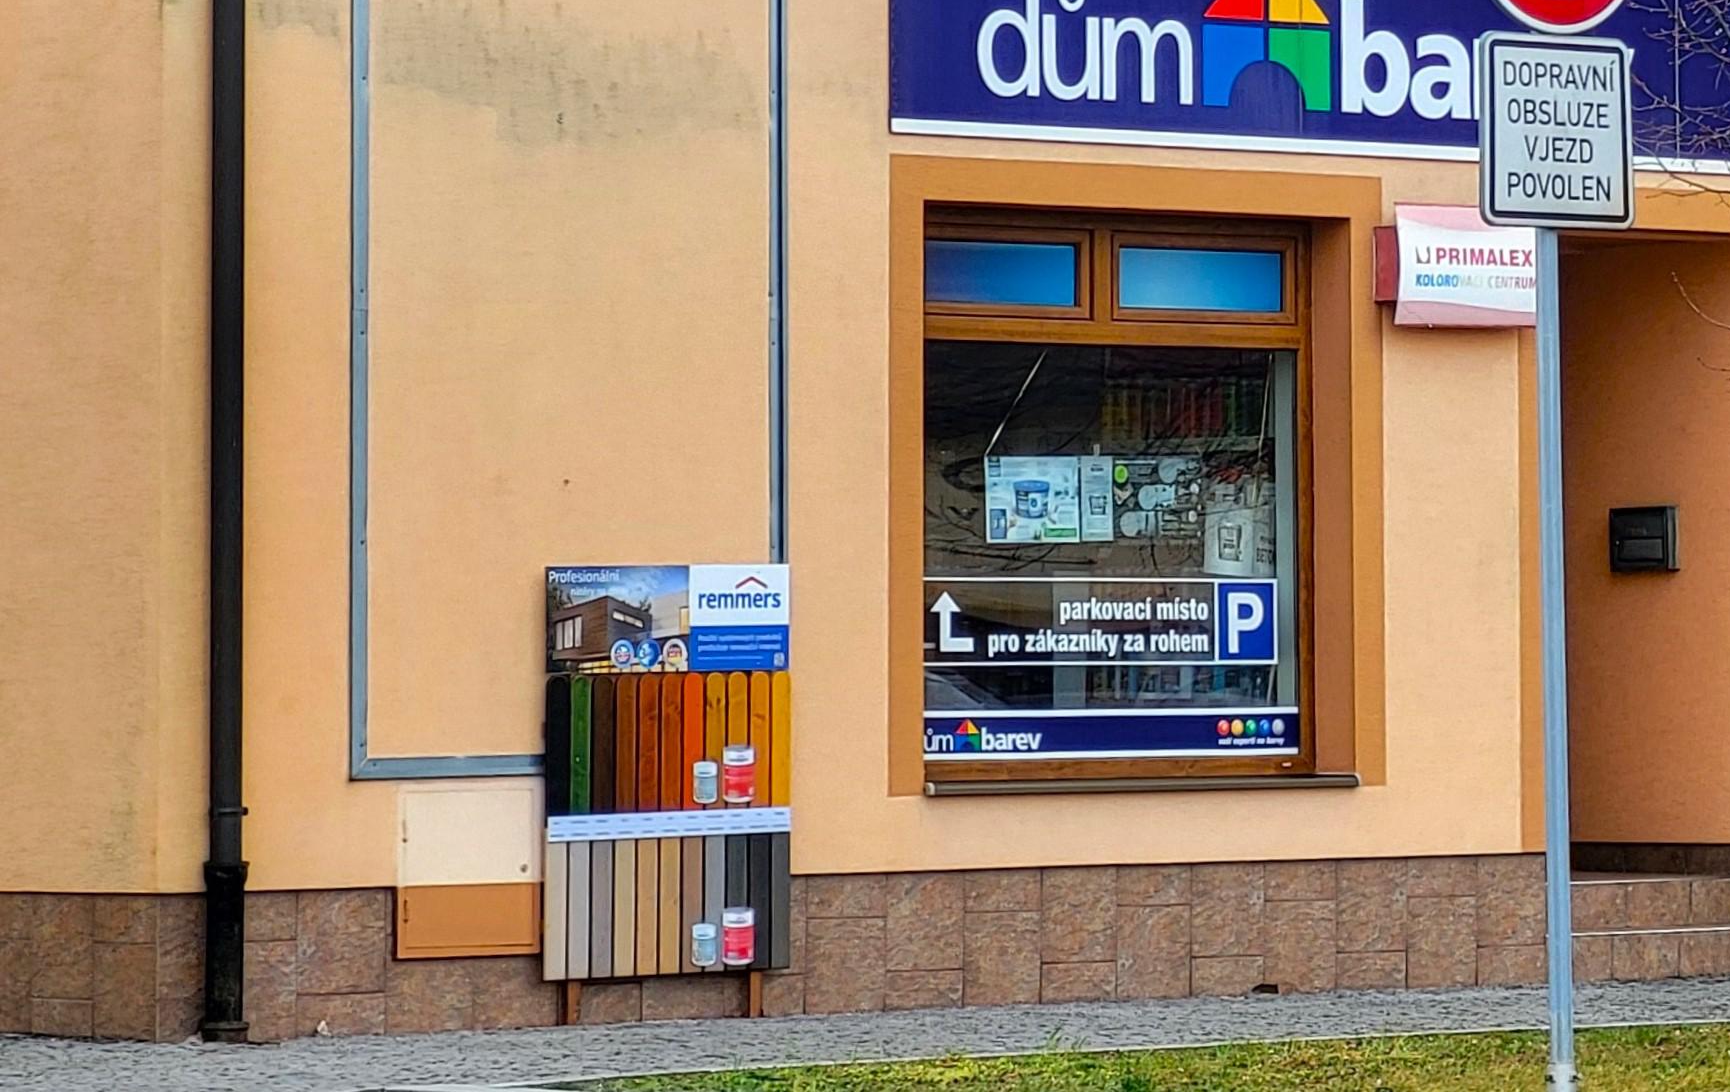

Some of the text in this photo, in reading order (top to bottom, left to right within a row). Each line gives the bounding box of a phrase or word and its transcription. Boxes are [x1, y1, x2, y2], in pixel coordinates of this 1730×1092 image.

[1502, 59, 1616, 93] DOPRAVNÍ
[1507, 98, 1611, 129] OBSLUZE
[1523, 134, 1594, 164] VJEZD
[1507, 171, 1612, 202] POVOLEN
[1435, 246, 1534, 268] PRIMALEX
[698, 591, 782, 609] remmers
[1059, 591, 1264, 654] parkovací místo P
[987, 628, 1209, 658] pro zákazníky za rohem
[924, 728, 954, 752] ům
[981, 726, 1042, 751] barev
